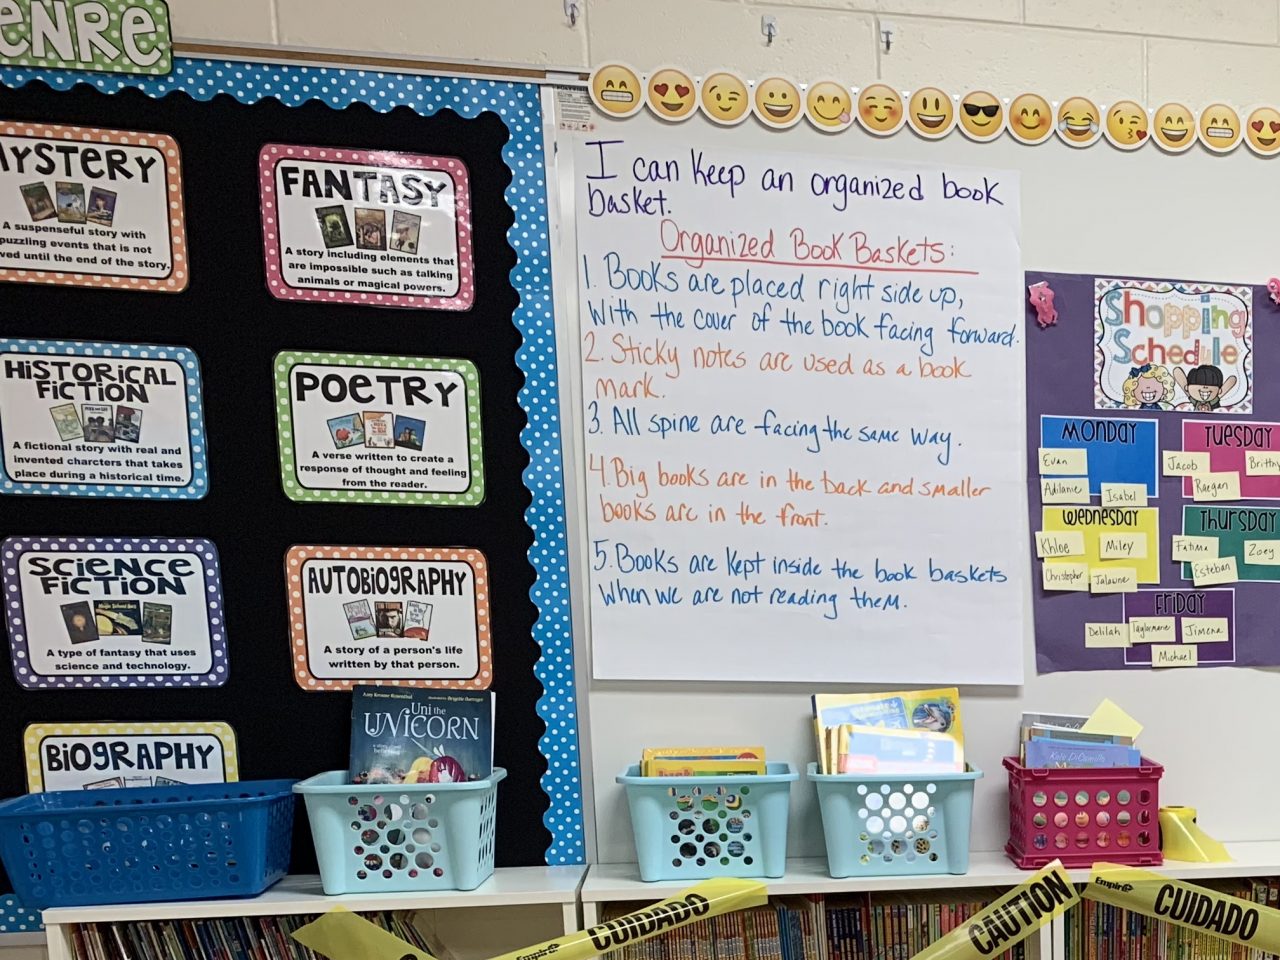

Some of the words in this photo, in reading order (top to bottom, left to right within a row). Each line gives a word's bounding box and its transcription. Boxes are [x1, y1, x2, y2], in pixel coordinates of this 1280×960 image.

[281, 166, 447, 207] FANTASY
[585, 140, 624, 180] I
[633, 156, 680, 182] can
[762, 168, 794, 192] an
[811, 173, 924, 211] organized
[943, 172, 1005, 206] book
[3, 221, 11, 230] A
[15, 223, 85, 235] suspenseful
[88, 228, 118, 239] story
[121, 229, 146, 239] with
[660, 218, 775, 268] Organized
[790, 228, 842, 262] Book
[380, 253, 430, 264] elements
[432, 257, 455, 266] that
[604, 251, 680, 292] Books
[687, 270, 725, 295] are
[731, 271, 805, 308] placed
[819, 273, 876, 315] right
[881, 277, 922, 304] side
[930, 285, 964, 312] up,
[651, 302, 685, 330] the
[693, 308, 738, 332] cover
[752, 303, 772, 332] of
[780, 307, 814, 336] the
[821, 311, 868, 339] book
[874, 312, 934, 356] facing
[1105, 290, 1245, 339] Shopping
[584, 331, 605, 364] 2.
[612, 331, 681, 379] Sticky
[693, 342, 747, 369] notes
[1113, 327, 1239, 366] Schedule
[13, 442, 21, 450] A
[24, 441, 72, 452] fictional
[75, 444, 105, 454] story
[125, 458, 148, 468] that
[151, 459, 183, 469] takes
[311, 450, 320, 459] A
[355, 452, 394, 462] written
[1168, 457, 1198, 471] Jacob
[616, 542, 680, 574] Books
[689, 551, 717, 572] are
[772, 556, 823, 576] inside
[831, 560, 861, 580] the
[875, 562, 917, 583] book
[928, 558, 1008, 584] baskets
[1105, 541, 1135, 556] Miley
[1248, 544, 1275, 560] Zoey
[58, 650, 83, 659] type
[86, 649, 97, 657] of
[100, 649, 142, 659] fantasy
[336, 646, 365, 655] story
[368, 646, 380, 654] of
[411, 702, 432, 716] Uni
[434, 706, 447, 715] the
[588, 892, 710, 950] CUIDADO
[968, 869, 1074, 955] CAUTION
[1154, 883, 1260, 941] CUIDADO
